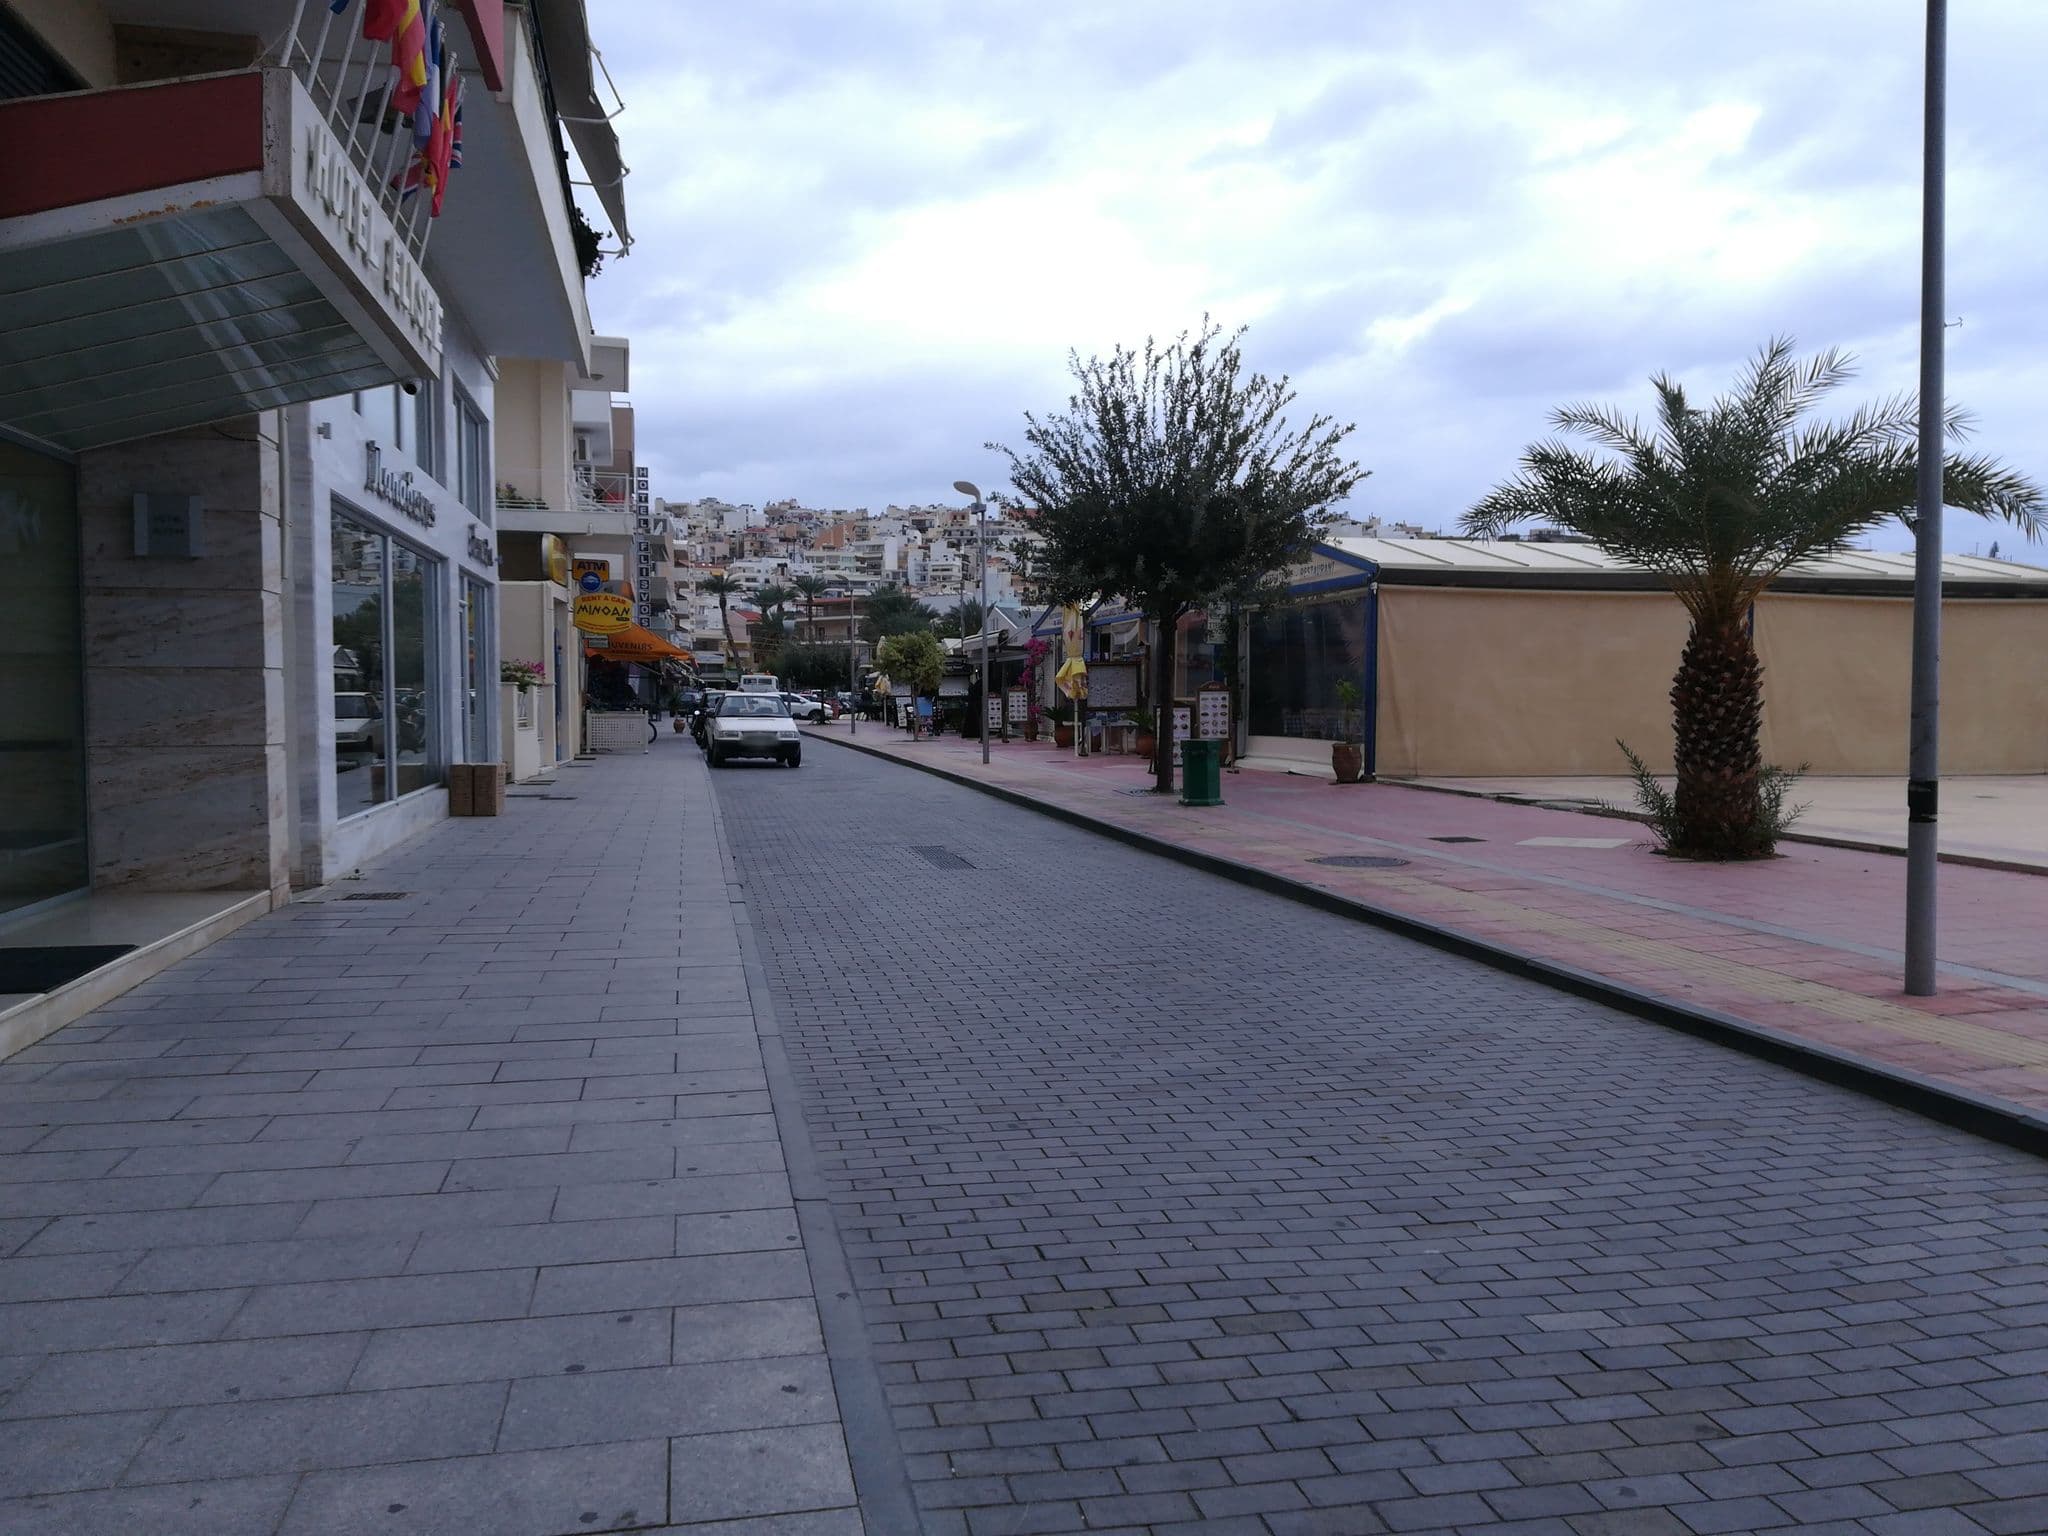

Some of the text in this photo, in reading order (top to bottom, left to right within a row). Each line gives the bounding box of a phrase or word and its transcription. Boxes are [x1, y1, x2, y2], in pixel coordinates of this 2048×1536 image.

[638, 467, 650, 627] HOTEL FLISVOS
[577, 561, 606, 571] ATM
[576, 604, 630, 616] MINOAN
